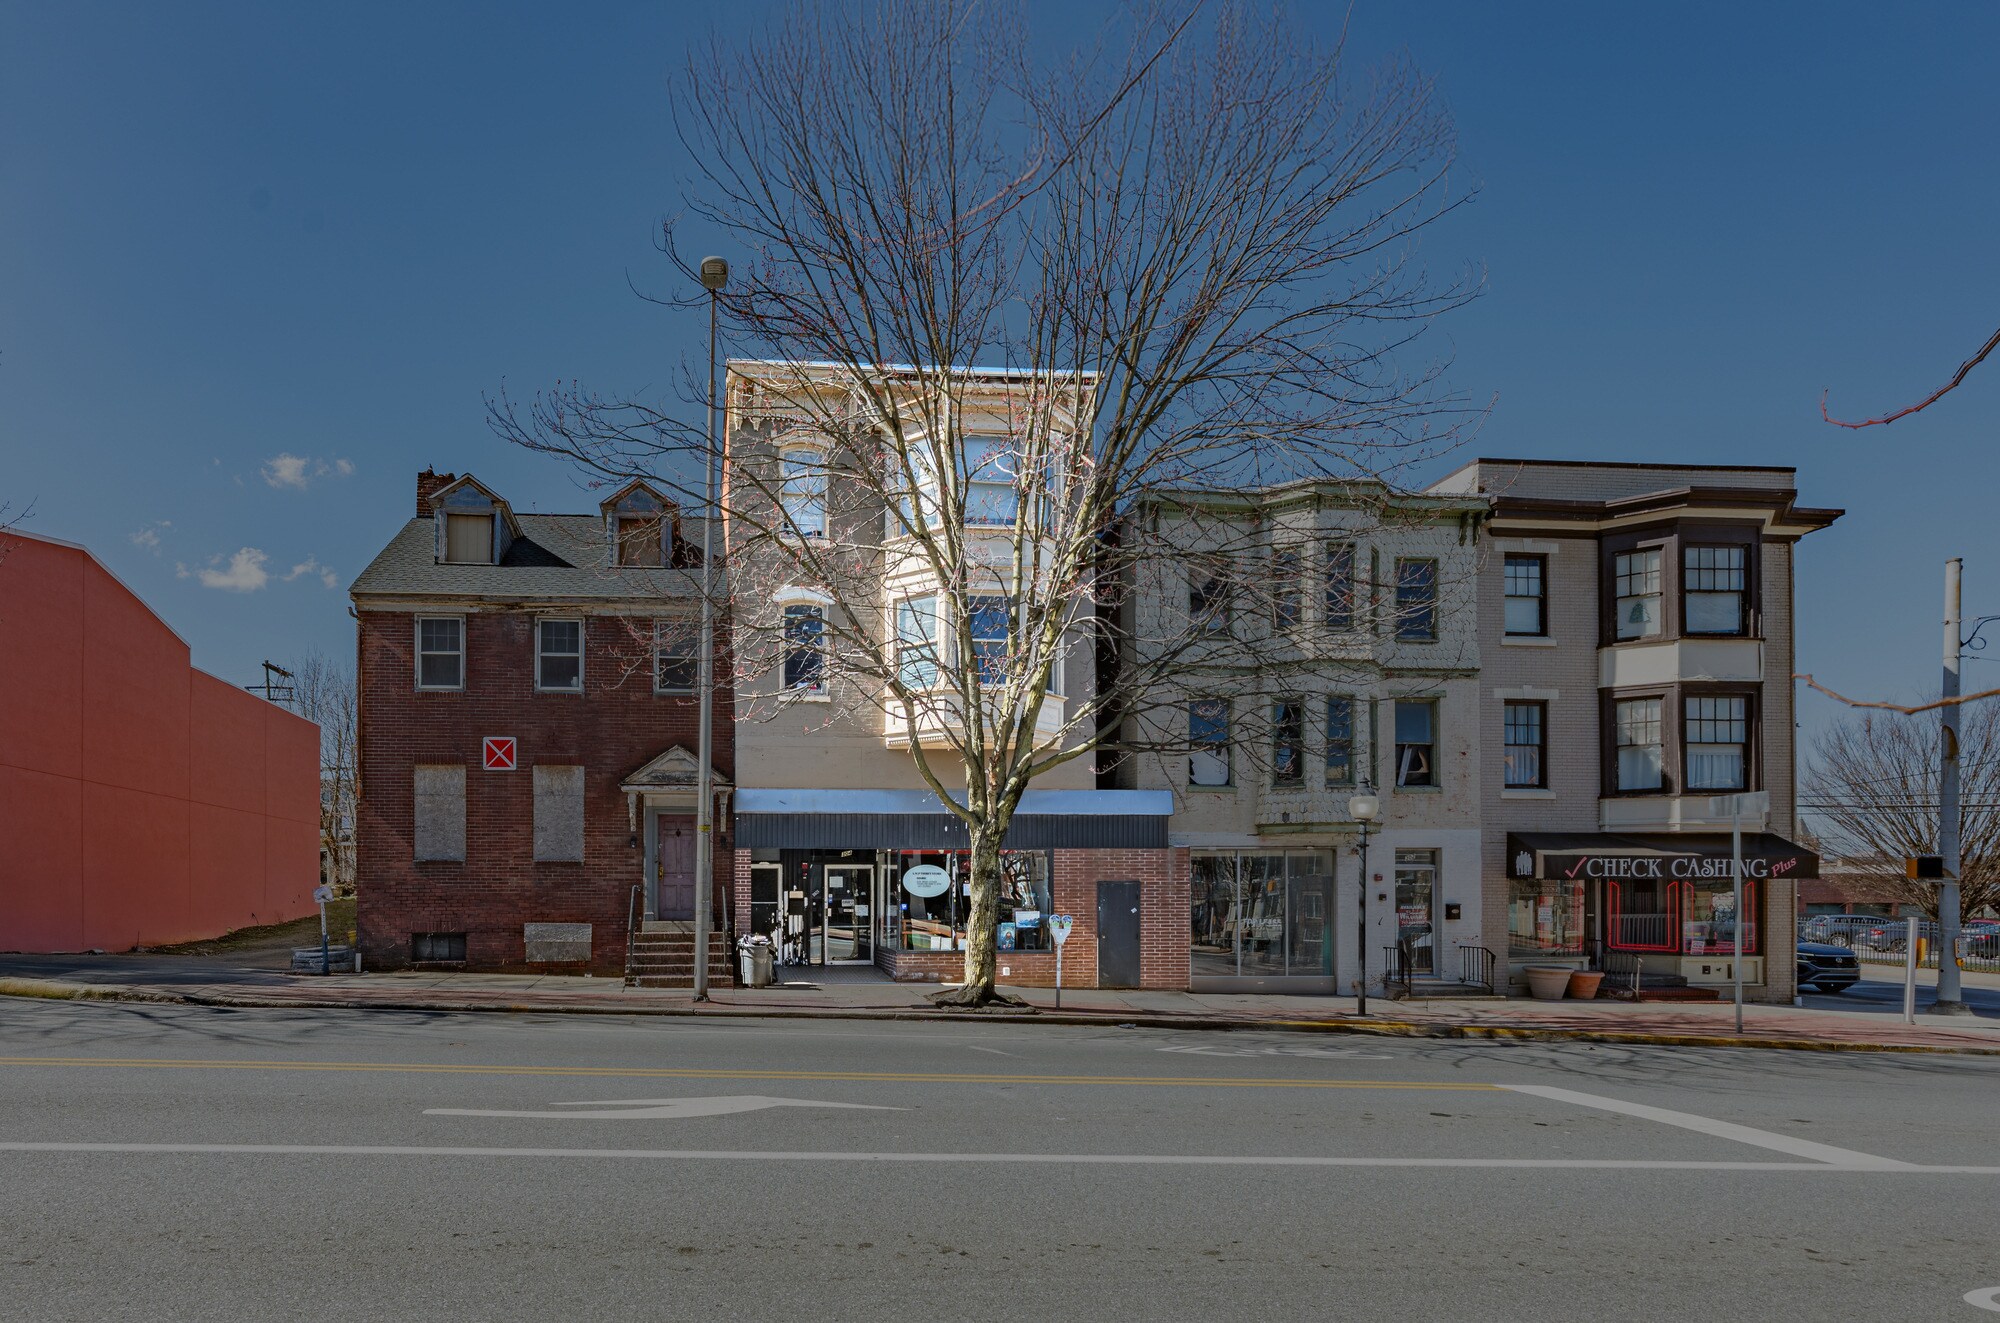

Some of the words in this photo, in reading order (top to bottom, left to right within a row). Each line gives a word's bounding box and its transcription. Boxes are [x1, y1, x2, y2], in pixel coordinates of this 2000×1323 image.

[1586, 858, 1663, 877] CHECK
[1671, 858, 1768, 877] CASHING
[1771, 857, 1797, 877] Plus
